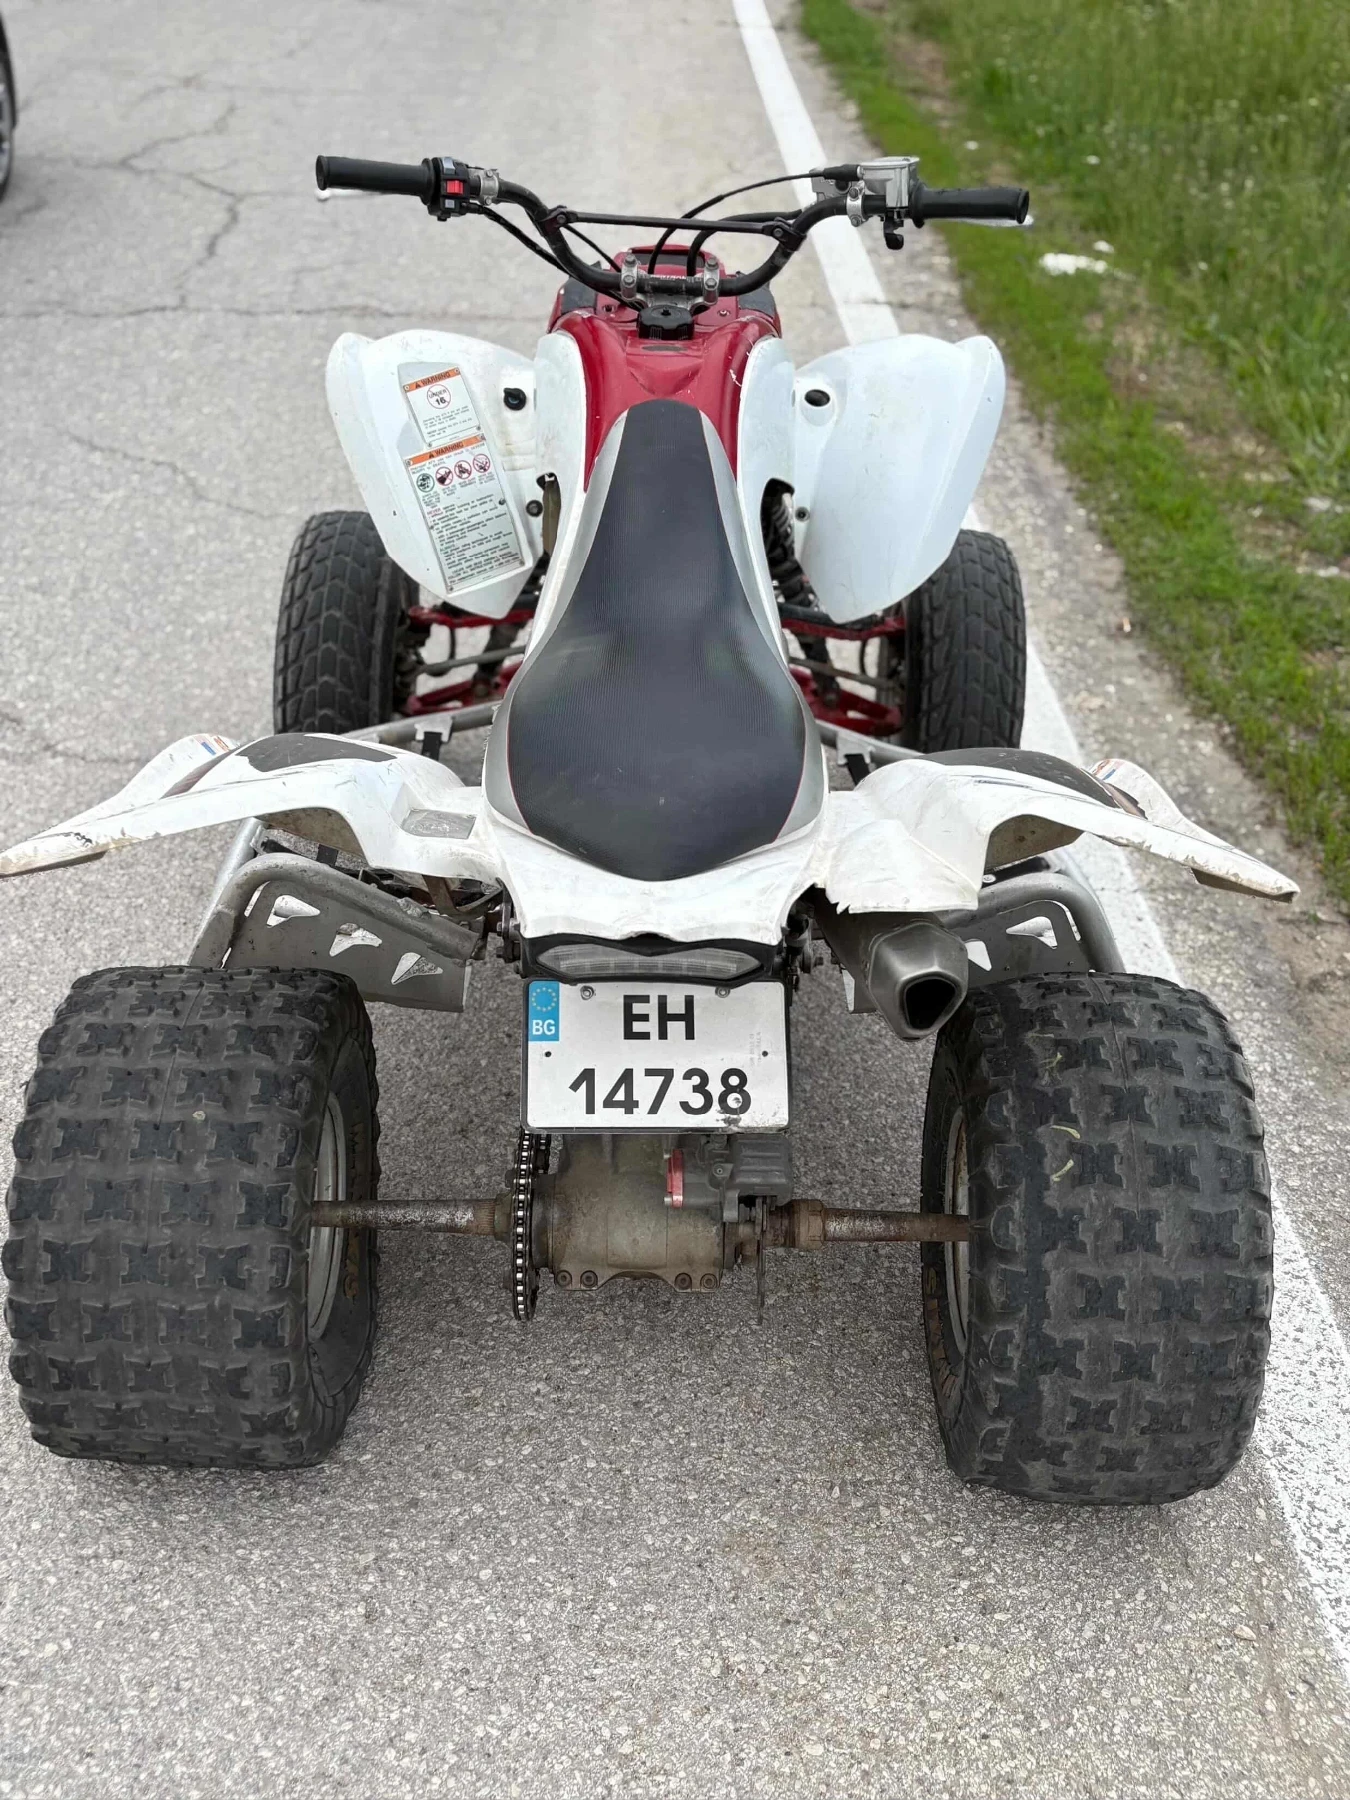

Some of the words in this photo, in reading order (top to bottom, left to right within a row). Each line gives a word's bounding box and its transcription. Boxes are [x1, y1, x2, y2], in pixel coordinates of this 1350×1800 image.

[421, 372, 450, 386] WARNING
[436, 396, 447, 405] 16
[435, 441, 464, 456] WARNING
[623, 994, 695, 1040] EH
[532, 1019, 556, 1036] BG
[568, 1068, 751, 1115] 14738
